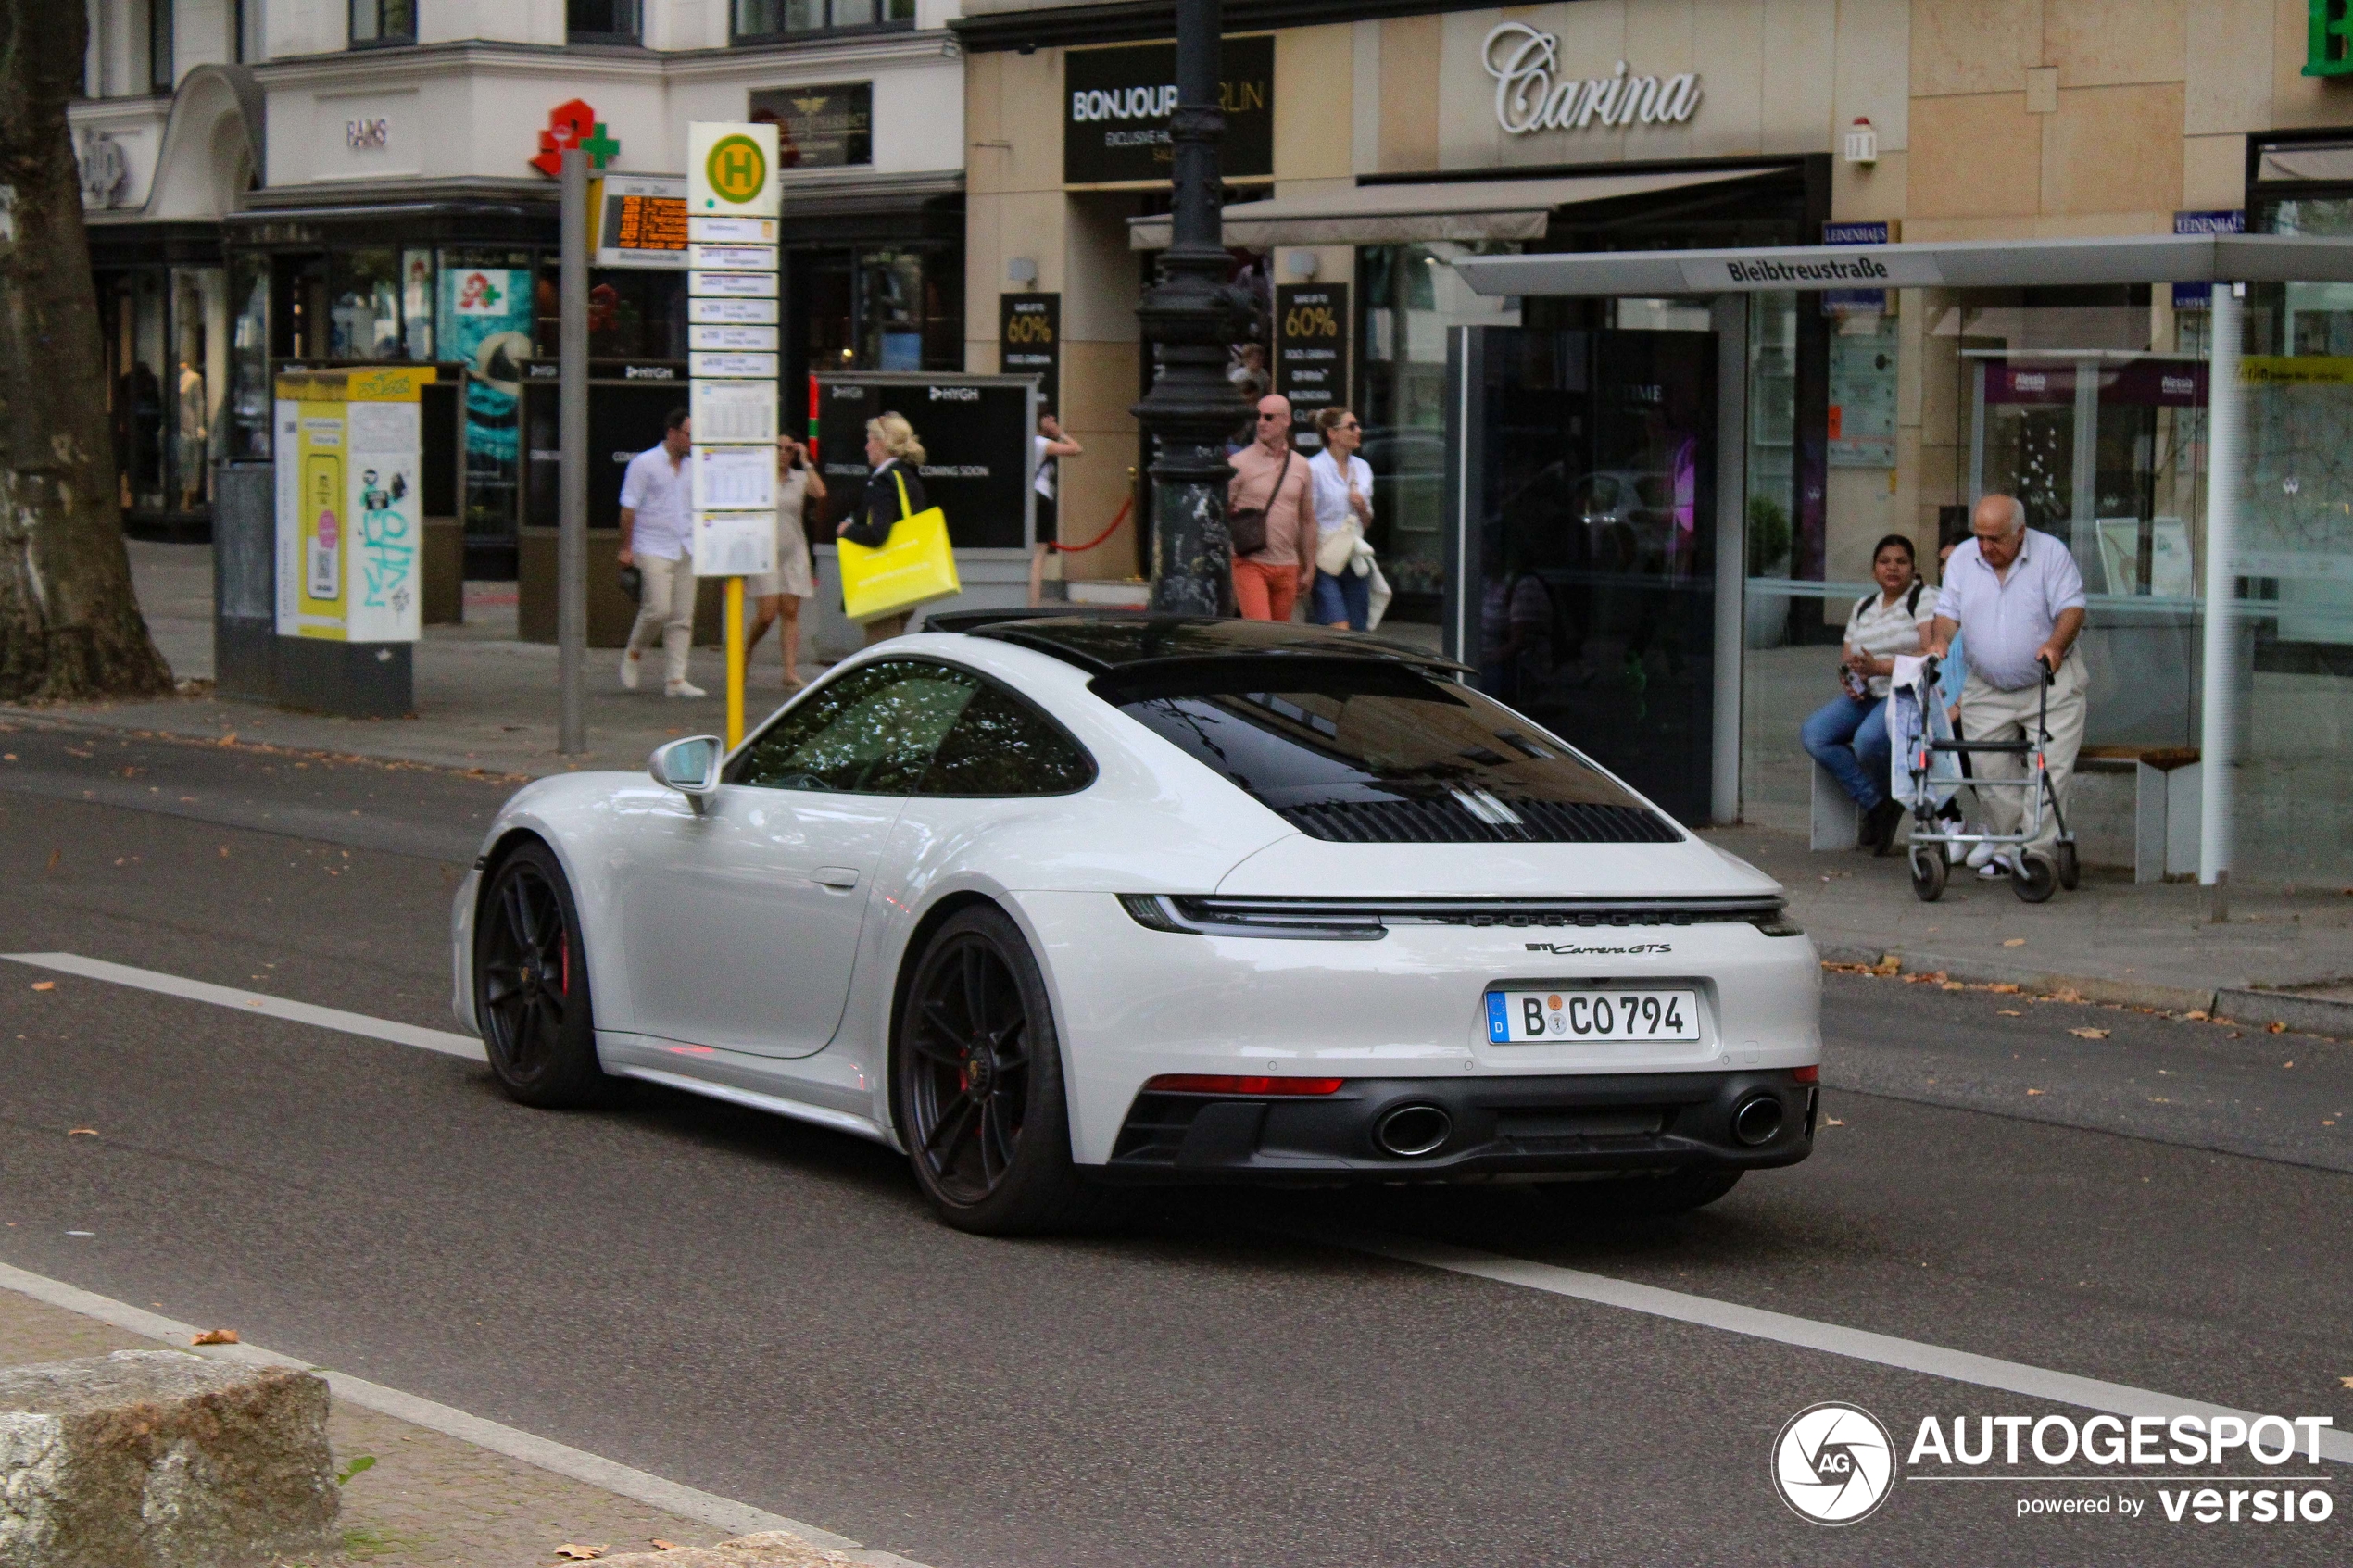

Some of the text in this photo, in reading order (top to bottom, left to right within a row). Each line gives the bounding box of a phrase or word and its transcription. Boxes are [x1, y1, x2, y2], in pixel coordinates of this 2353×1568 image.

[1483, 21, 1700, 134] Carina
[1072, 84, 1179, 122] BONJOUR
[724, 151, 752, 187] H
[1825, 227, 1887, 243] LEINENHAUS
[1727, 257, 1888, 282] Bleibtreustraße
[1007, 316, 1052, 342] 60%
[1285, 307, 1338, 337] 60%
[942, 388, 979, 400] HYGH
[919, 466, 989, 476] COMING SOON
[1552, 944, 1627, 955] Carrera
[1628, 944, 1672, 954] GTS
[1494, 1022, 1504, 1033] D
[1522, 997, 1546, 1035] B
